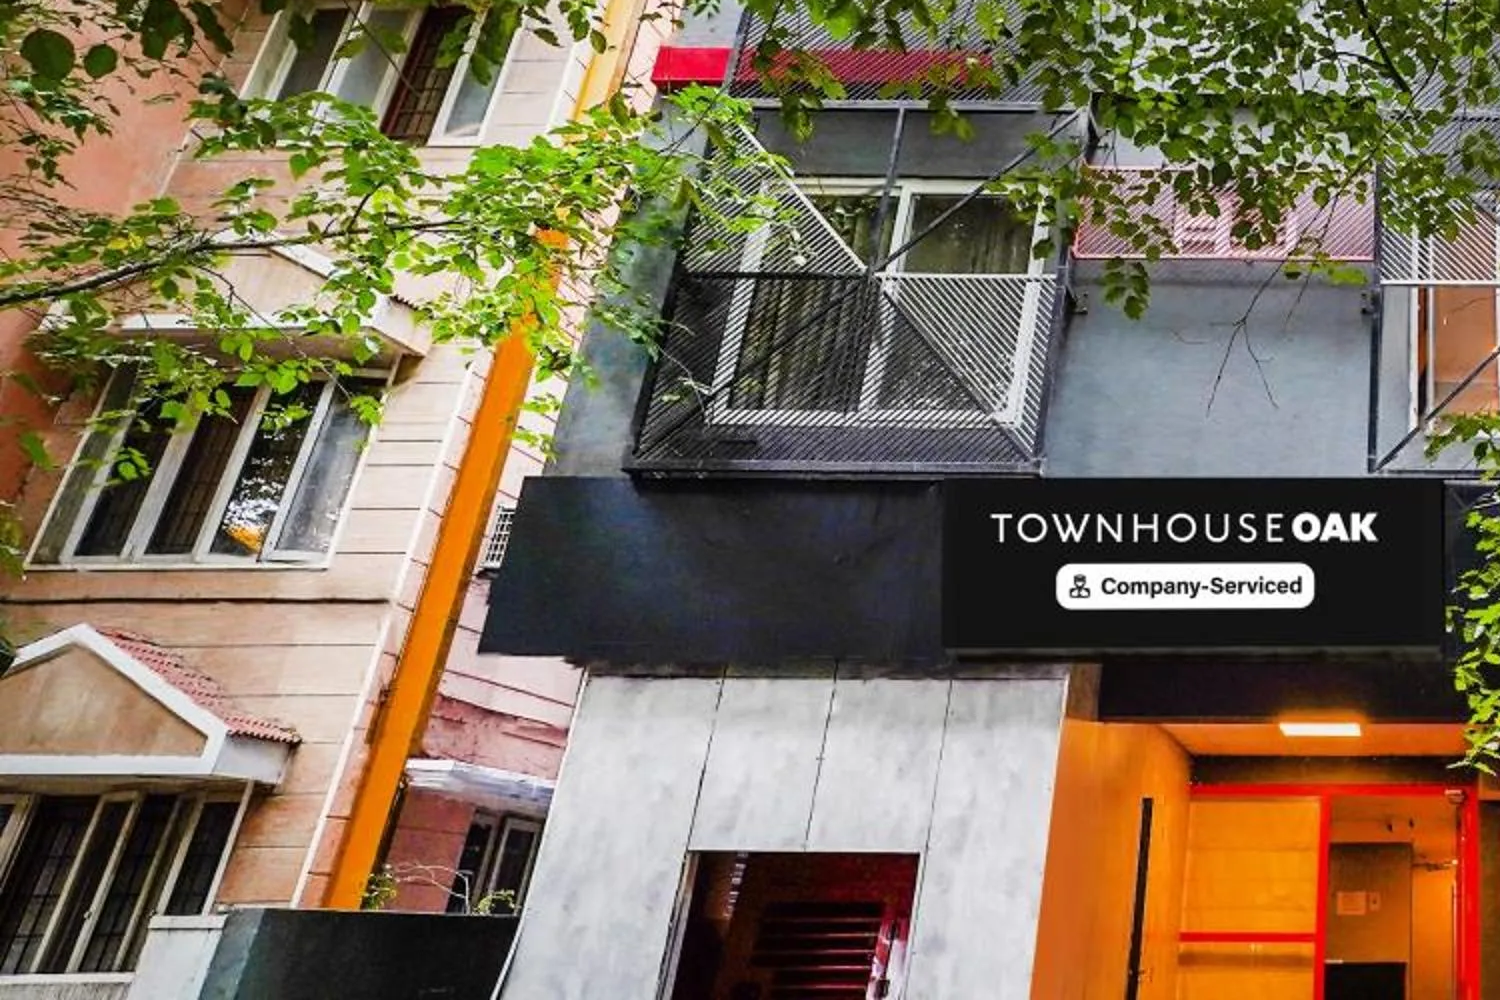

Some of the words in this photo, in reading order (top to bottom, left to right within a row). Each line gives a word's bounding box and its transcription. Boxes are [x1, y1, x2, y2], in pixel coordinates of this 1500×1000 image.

[990, 512, 1284, 543] TOWNHOUSE
[1291, 511, 1378, 543] OAK
[1101, 575, 1303, 599] Company-Serviced
